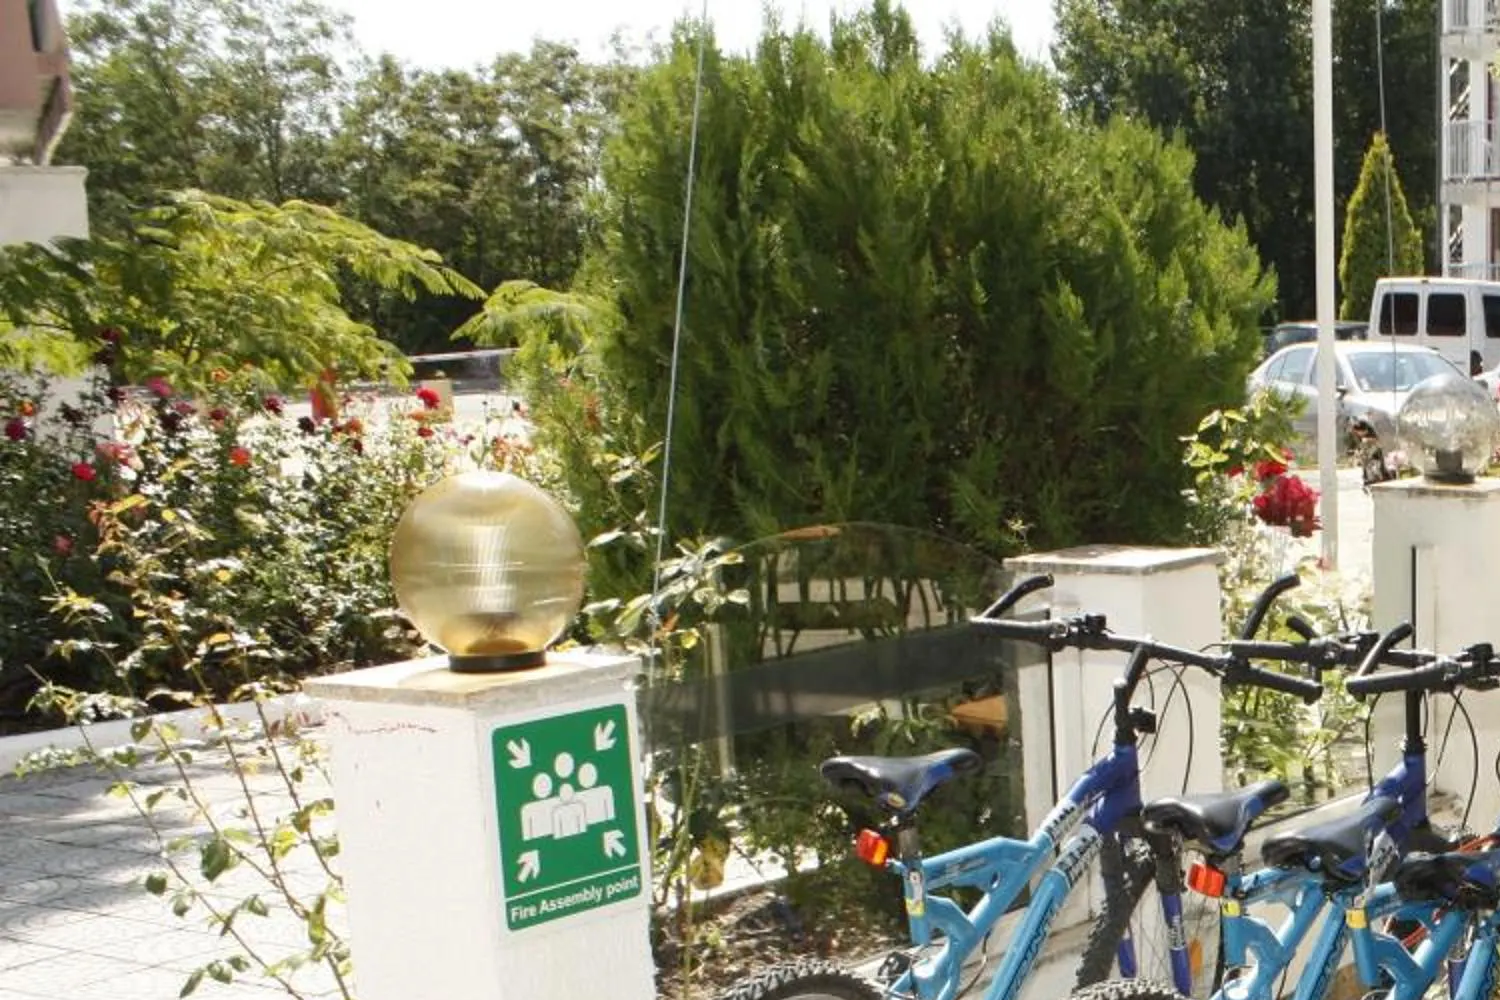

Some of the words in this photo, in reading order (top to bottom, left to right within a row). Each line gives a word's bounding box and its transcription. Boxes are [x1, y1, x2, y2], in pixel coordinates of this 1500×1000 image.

[511, 903, 537, 922] Fire
[540, 885, 603, 913] Assembly
[606, 876, 639, 898] point
